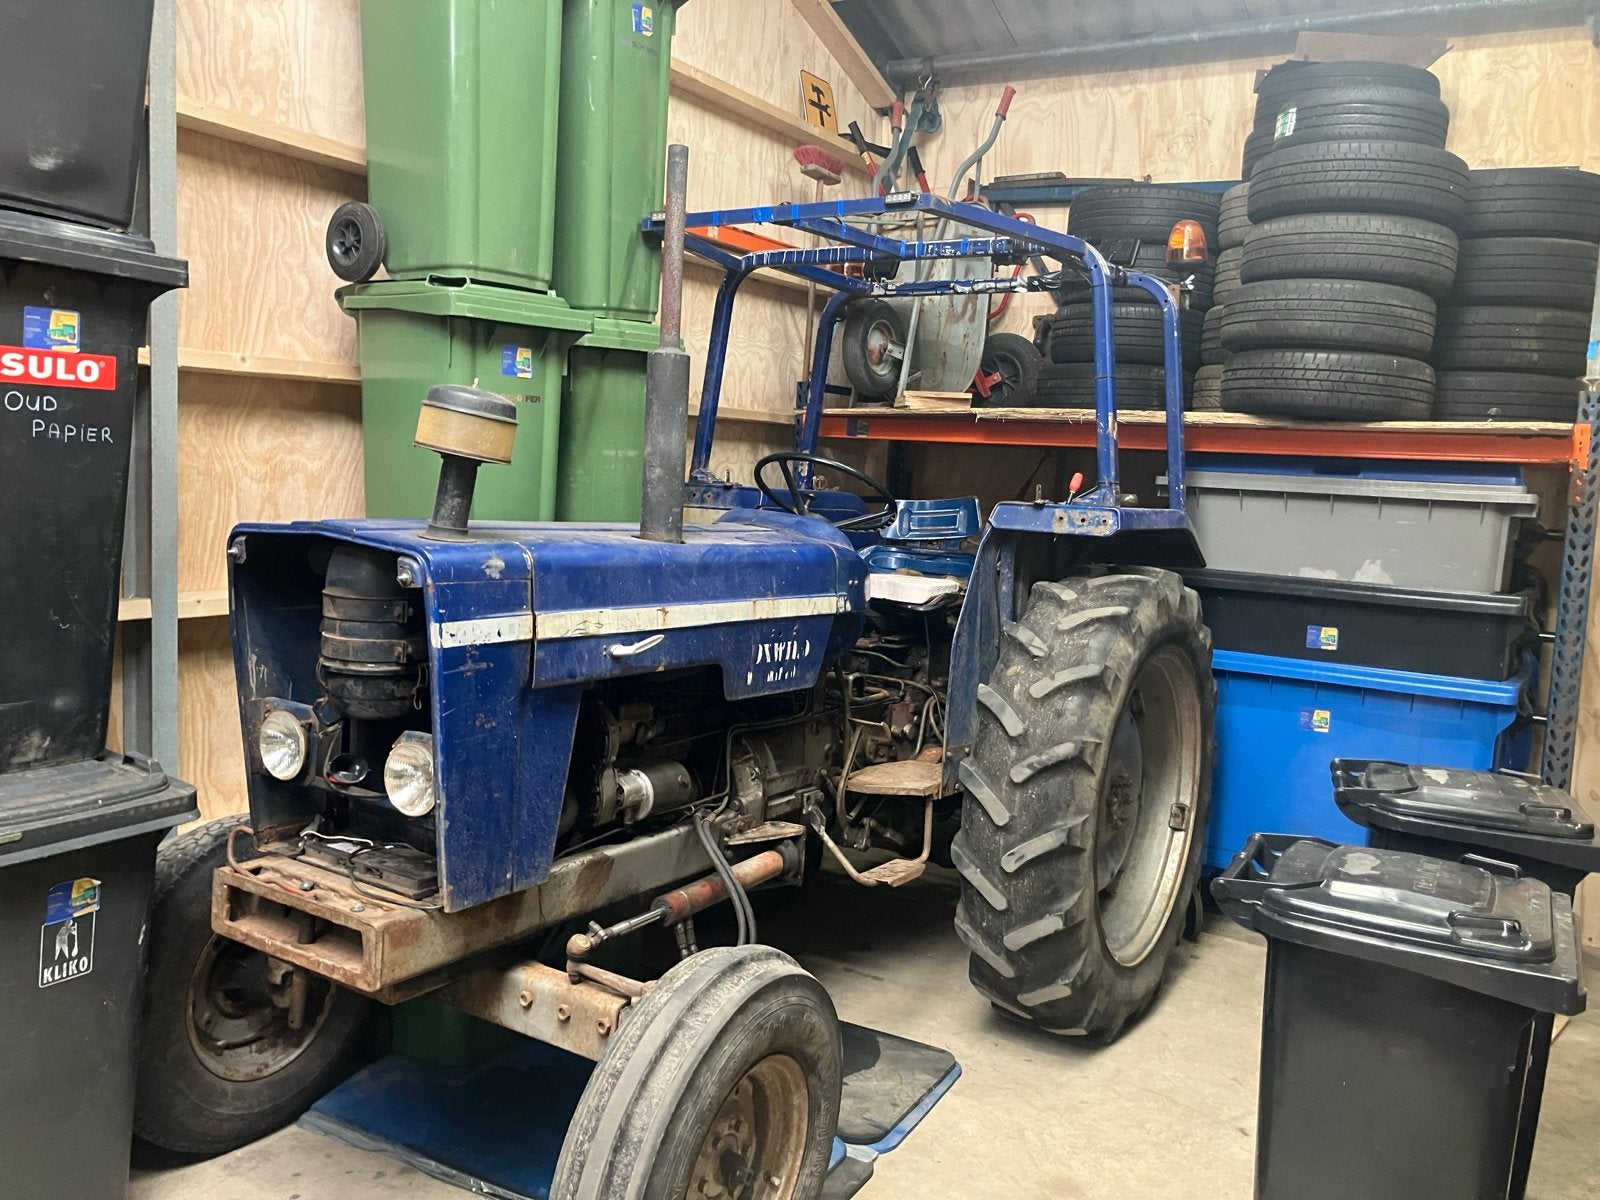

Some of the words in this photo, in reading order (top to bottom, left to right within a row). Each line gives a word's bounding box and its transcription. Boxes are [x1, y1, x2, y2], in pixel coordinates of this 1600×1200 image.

[0, 353, 100, 383] SULO
[4, 391, 57, 411] OUD
[43, 956, 88, 984] KLIKO
